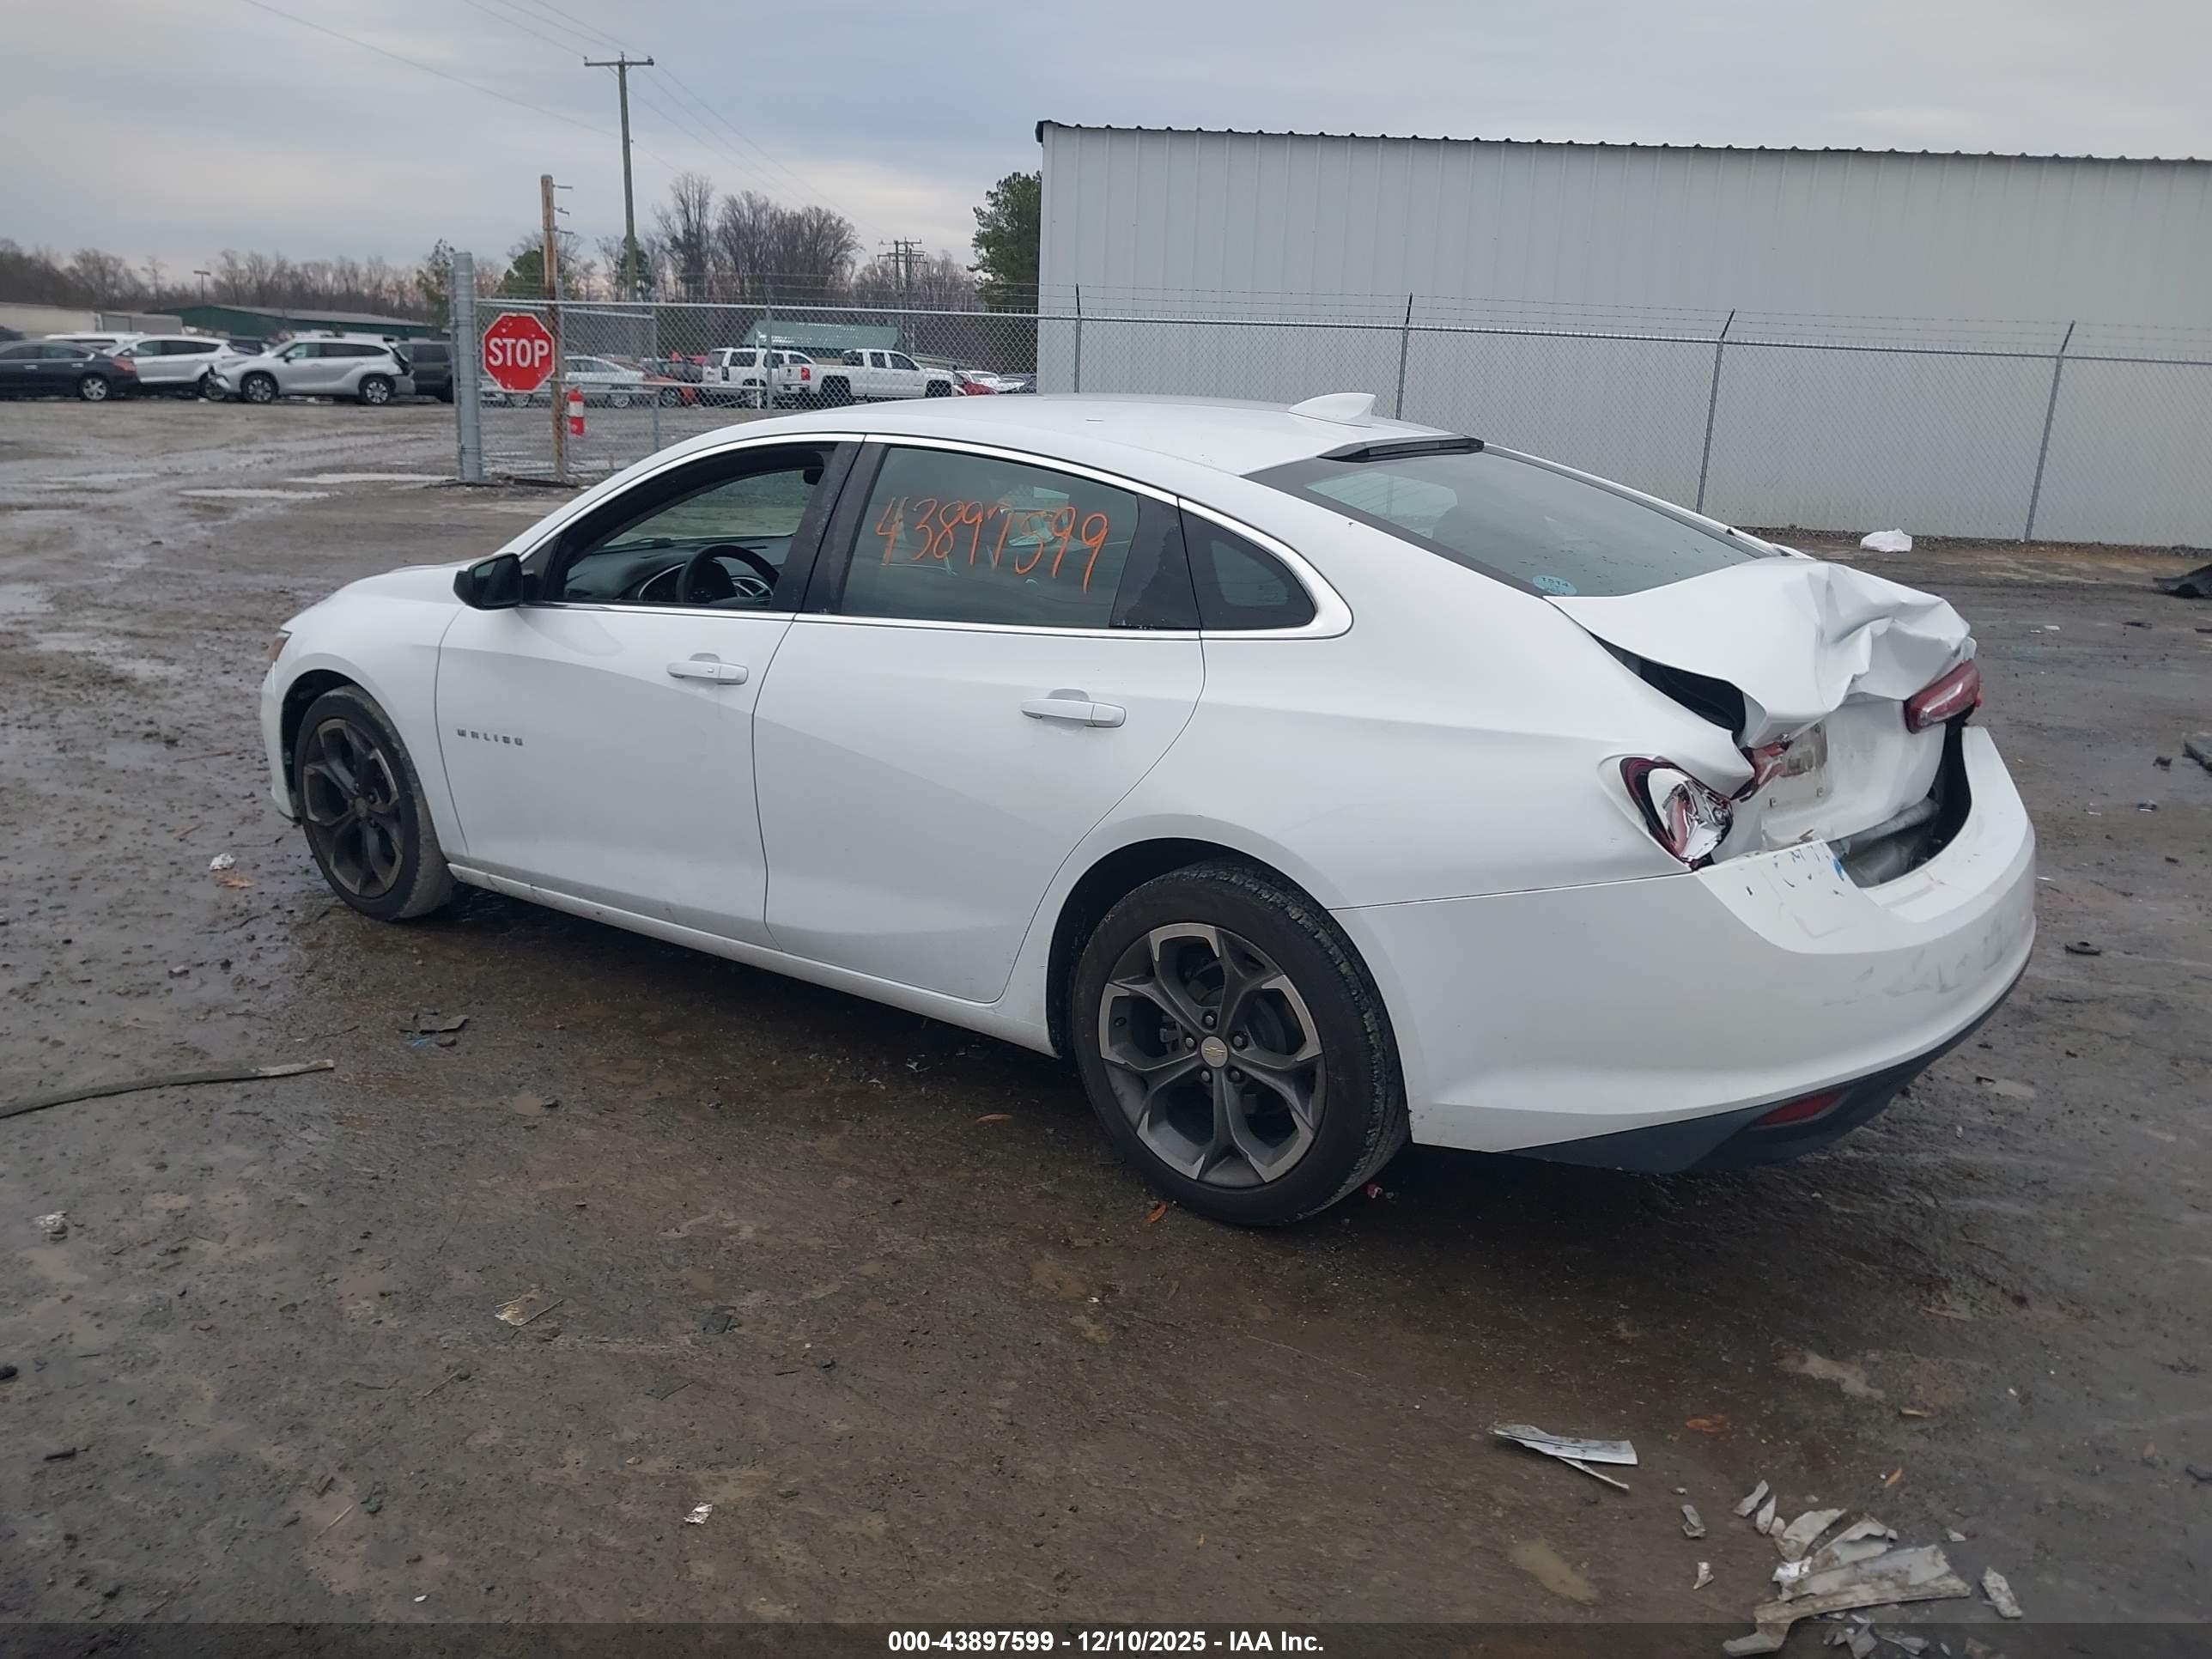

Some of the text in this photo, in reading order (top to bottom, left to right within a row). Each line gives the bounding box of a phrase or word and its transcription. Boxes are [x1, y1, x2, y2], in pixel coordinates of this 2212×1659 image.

[488, 337, 550, 368] STOP
[875, 496, 1109, 593] 43897599
[457, 728, 523, 746] MALIBU
